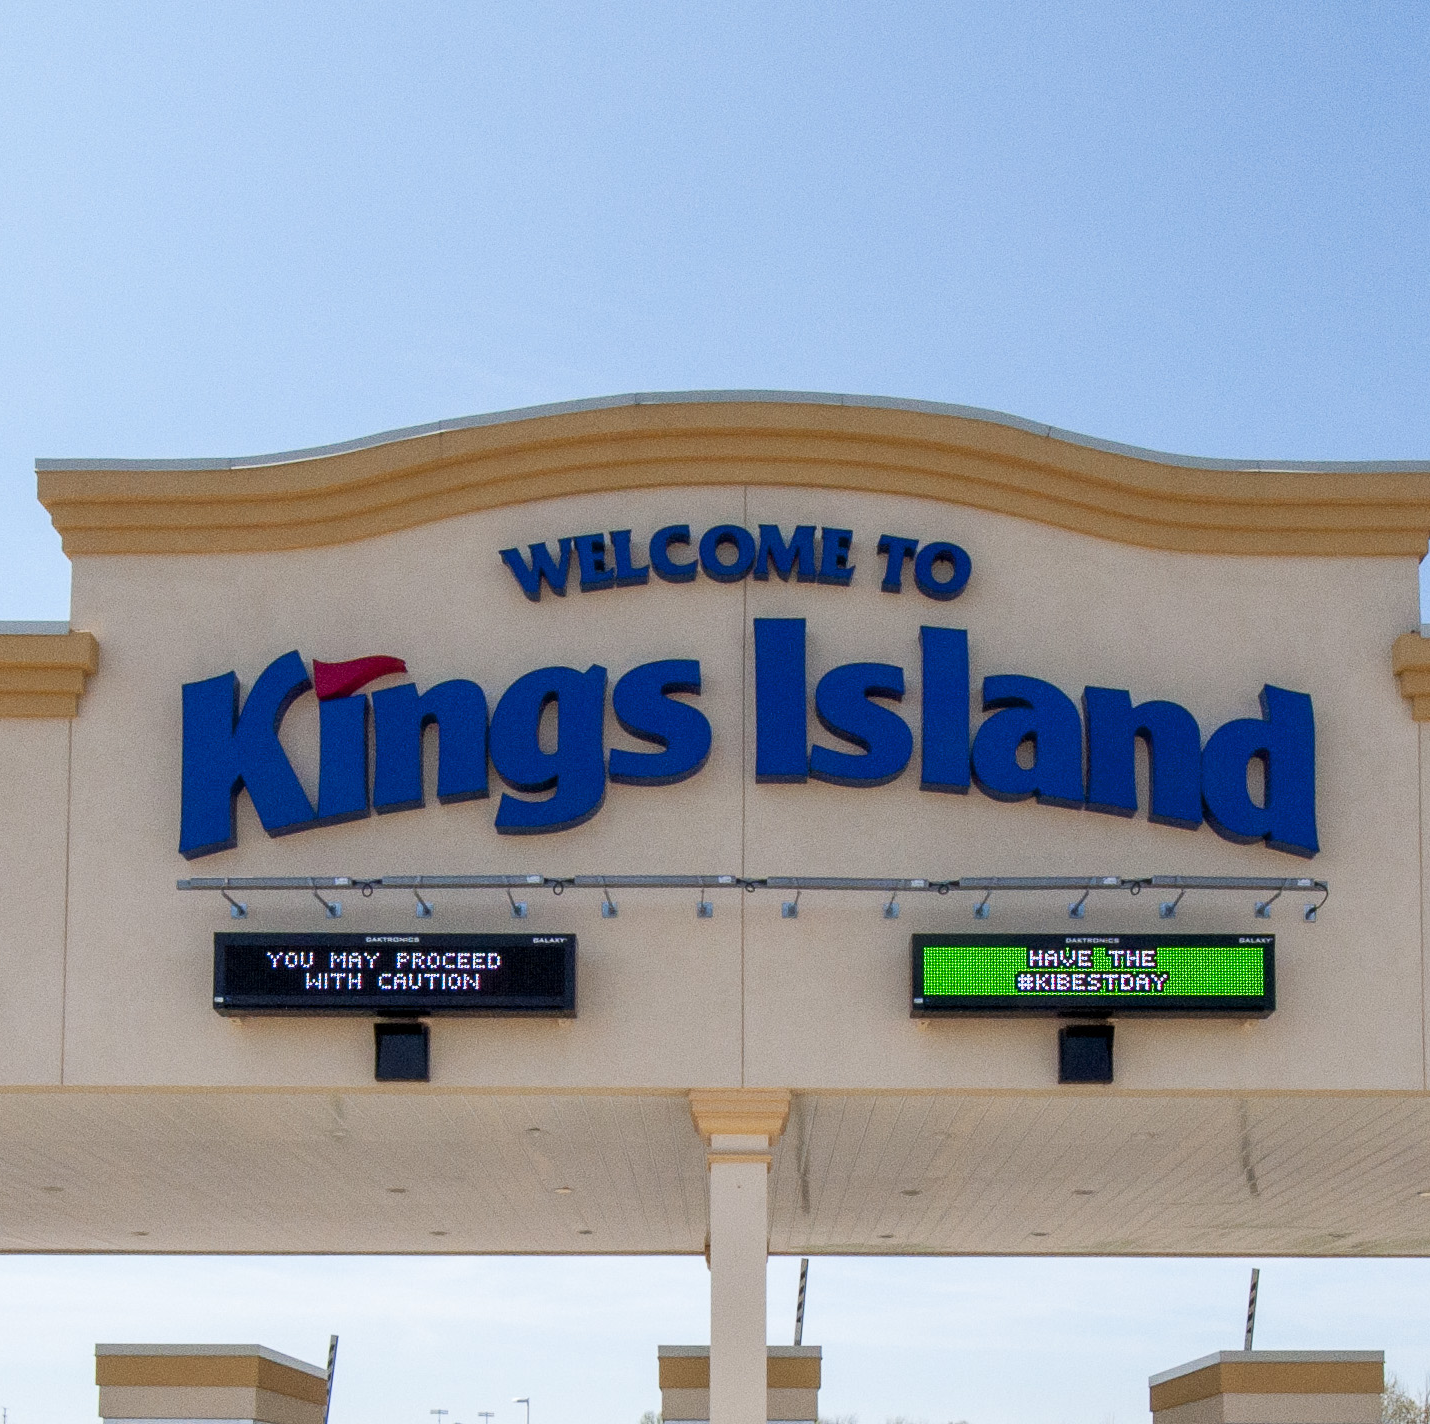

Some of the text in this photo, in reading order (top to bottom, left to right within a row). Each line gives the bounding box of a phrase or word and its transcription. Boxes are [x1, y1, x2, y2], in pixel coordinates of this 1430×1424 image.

[499, 523, 971, 602] WELCOME TO
[178, 617, 1320, 860] Kings Island
[266, 952, 502, 969] YOU MAY PROCEED
[1029, 950, 1157, 967] HAVE THE
[305, 973, 480, 990] WITH CAUTION
[1017, 973, 1169, 991] #KIBESTDAY
